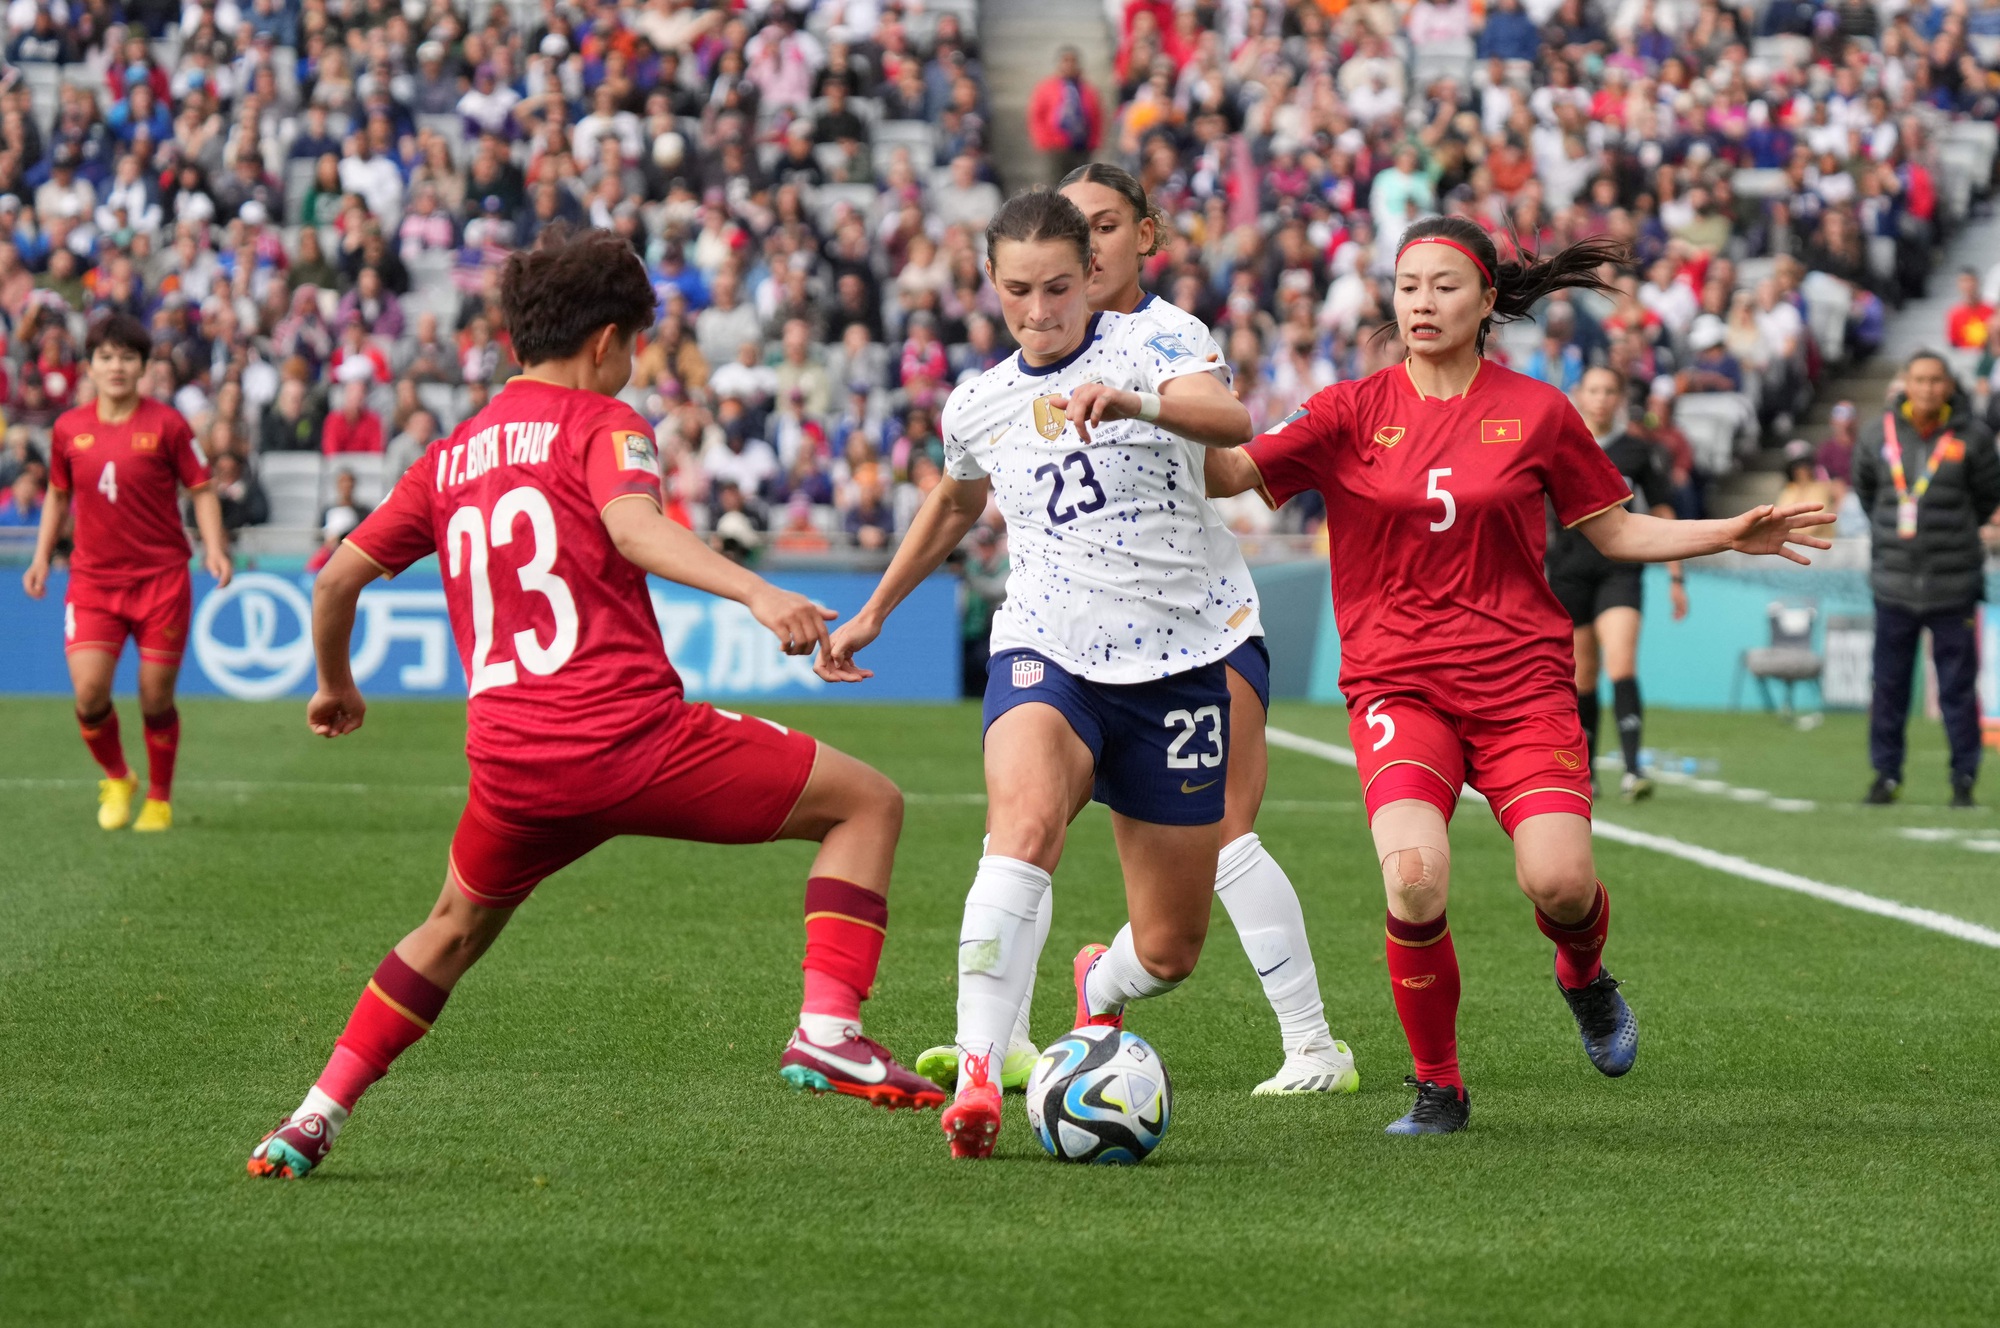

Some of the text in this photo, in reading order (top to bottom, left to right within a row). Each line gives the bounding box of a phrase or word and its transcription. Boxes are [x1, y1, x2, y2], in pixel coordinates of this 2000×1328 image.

[504, 421, 560, 466] THUY
[1044, 421, 1059, 432] FIFA
[98, 461, 118, 503] 4
[1034, 450, 1107, 527] 23
[1426, 467, 1457, 532] 5
[447, 485, 579, 699] 23
[1014, 661, 1042, 672] USA
[1163, 704, 1223, 769] 23
[1366, 698, 1396, 752] 5
